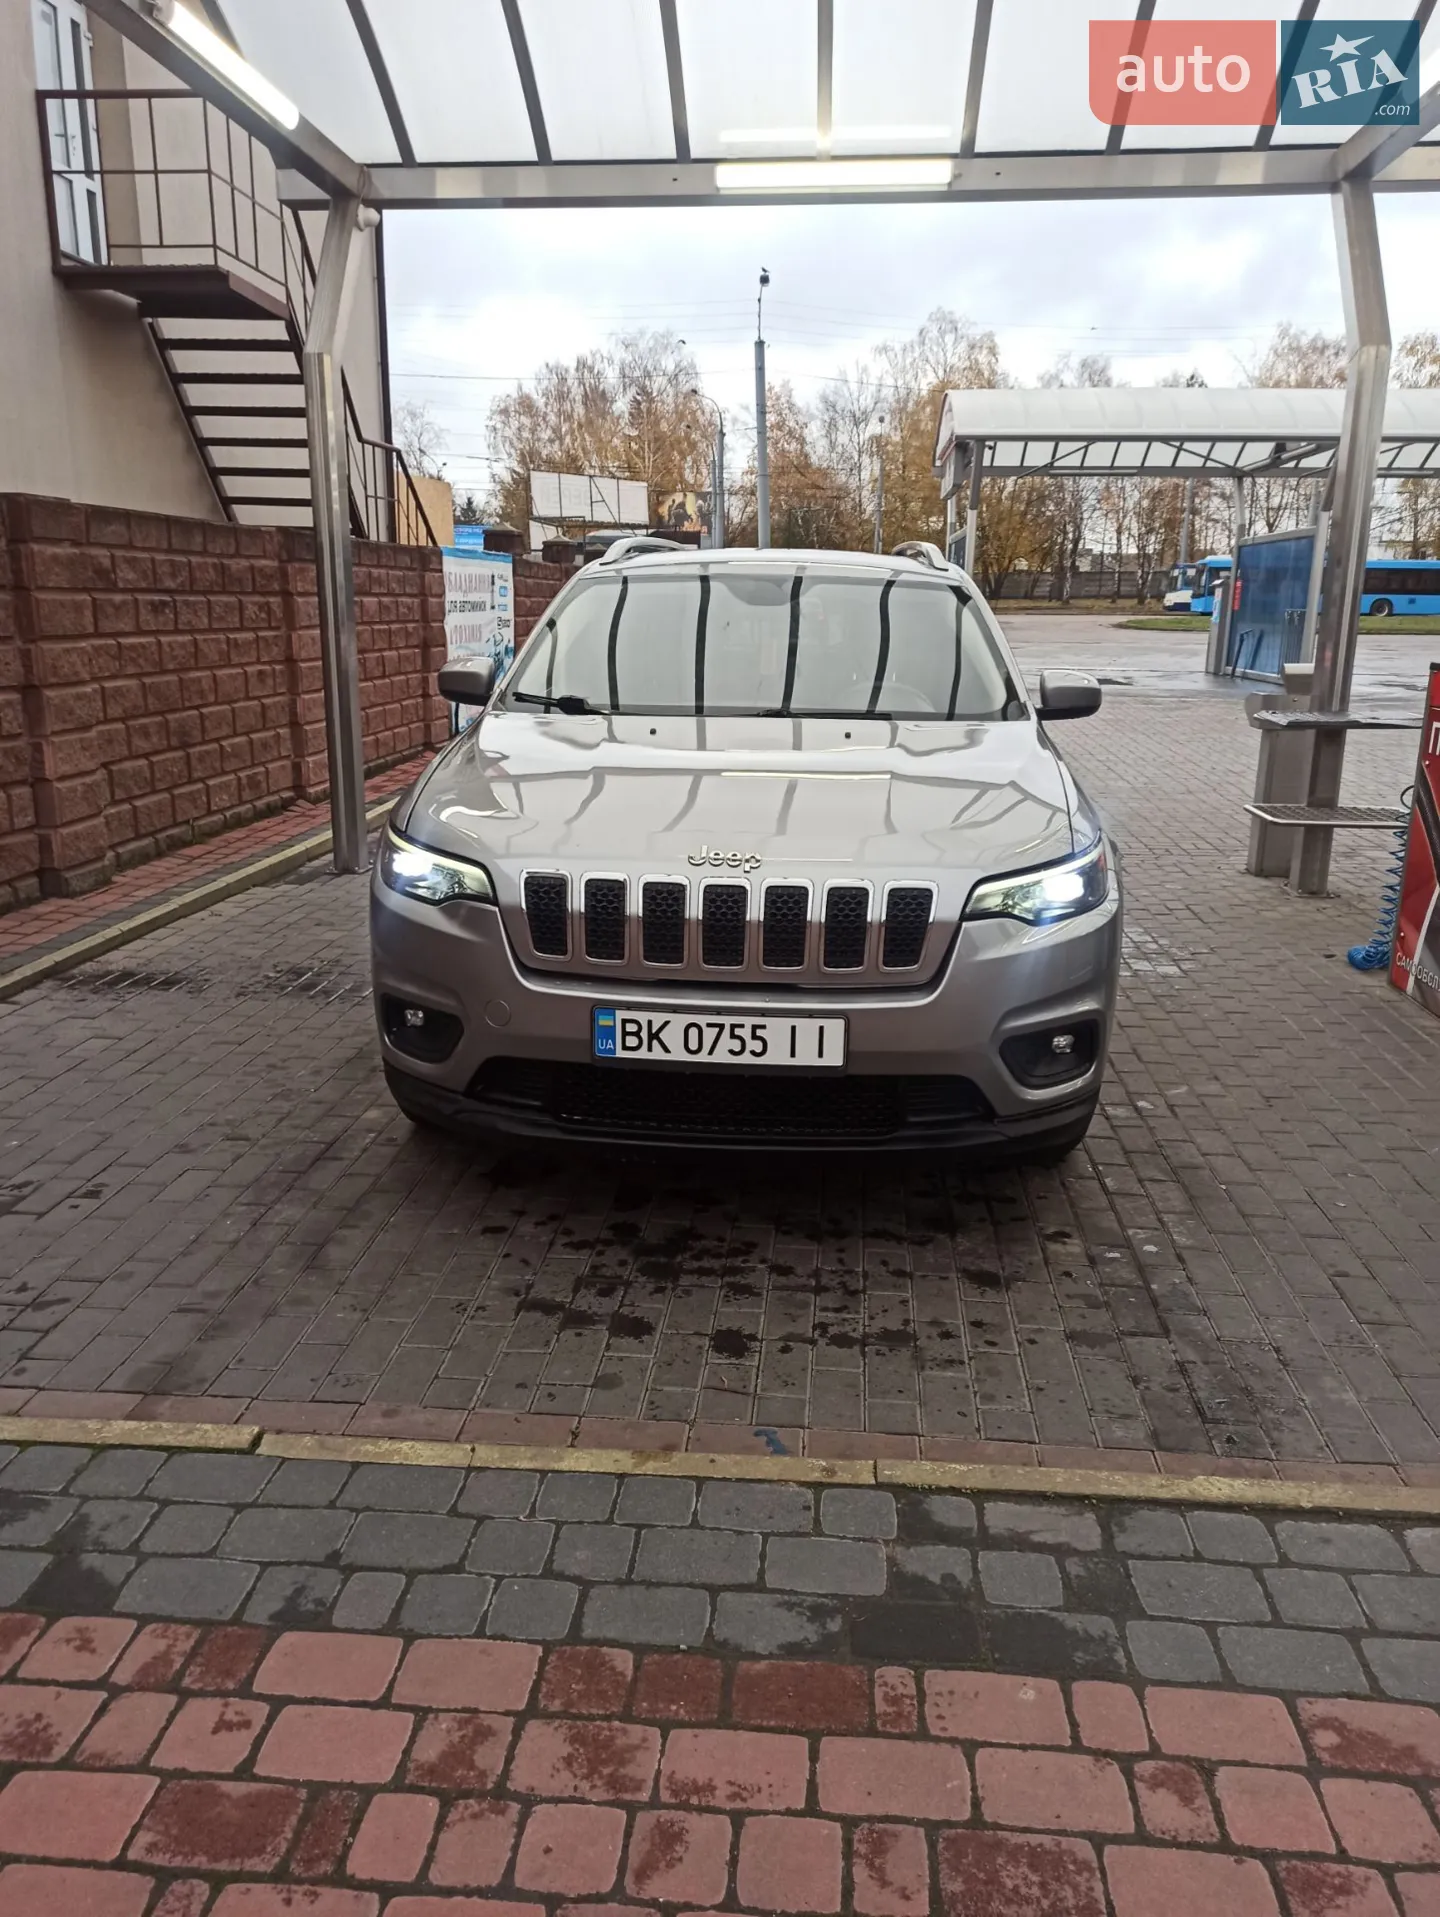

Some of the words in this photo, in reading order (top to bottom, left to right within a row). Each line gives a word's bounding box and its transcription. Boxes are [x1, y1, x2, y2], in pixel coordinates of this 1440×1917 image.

[688, 845, 762, 873] Jeep
[1396, 952, 1440, 991] САМООБСЛ
[598, 1039, 614, 1050] UA
[621, 1018, 672, 1054] BK
[683, 1021, 769, 1057] 0755
